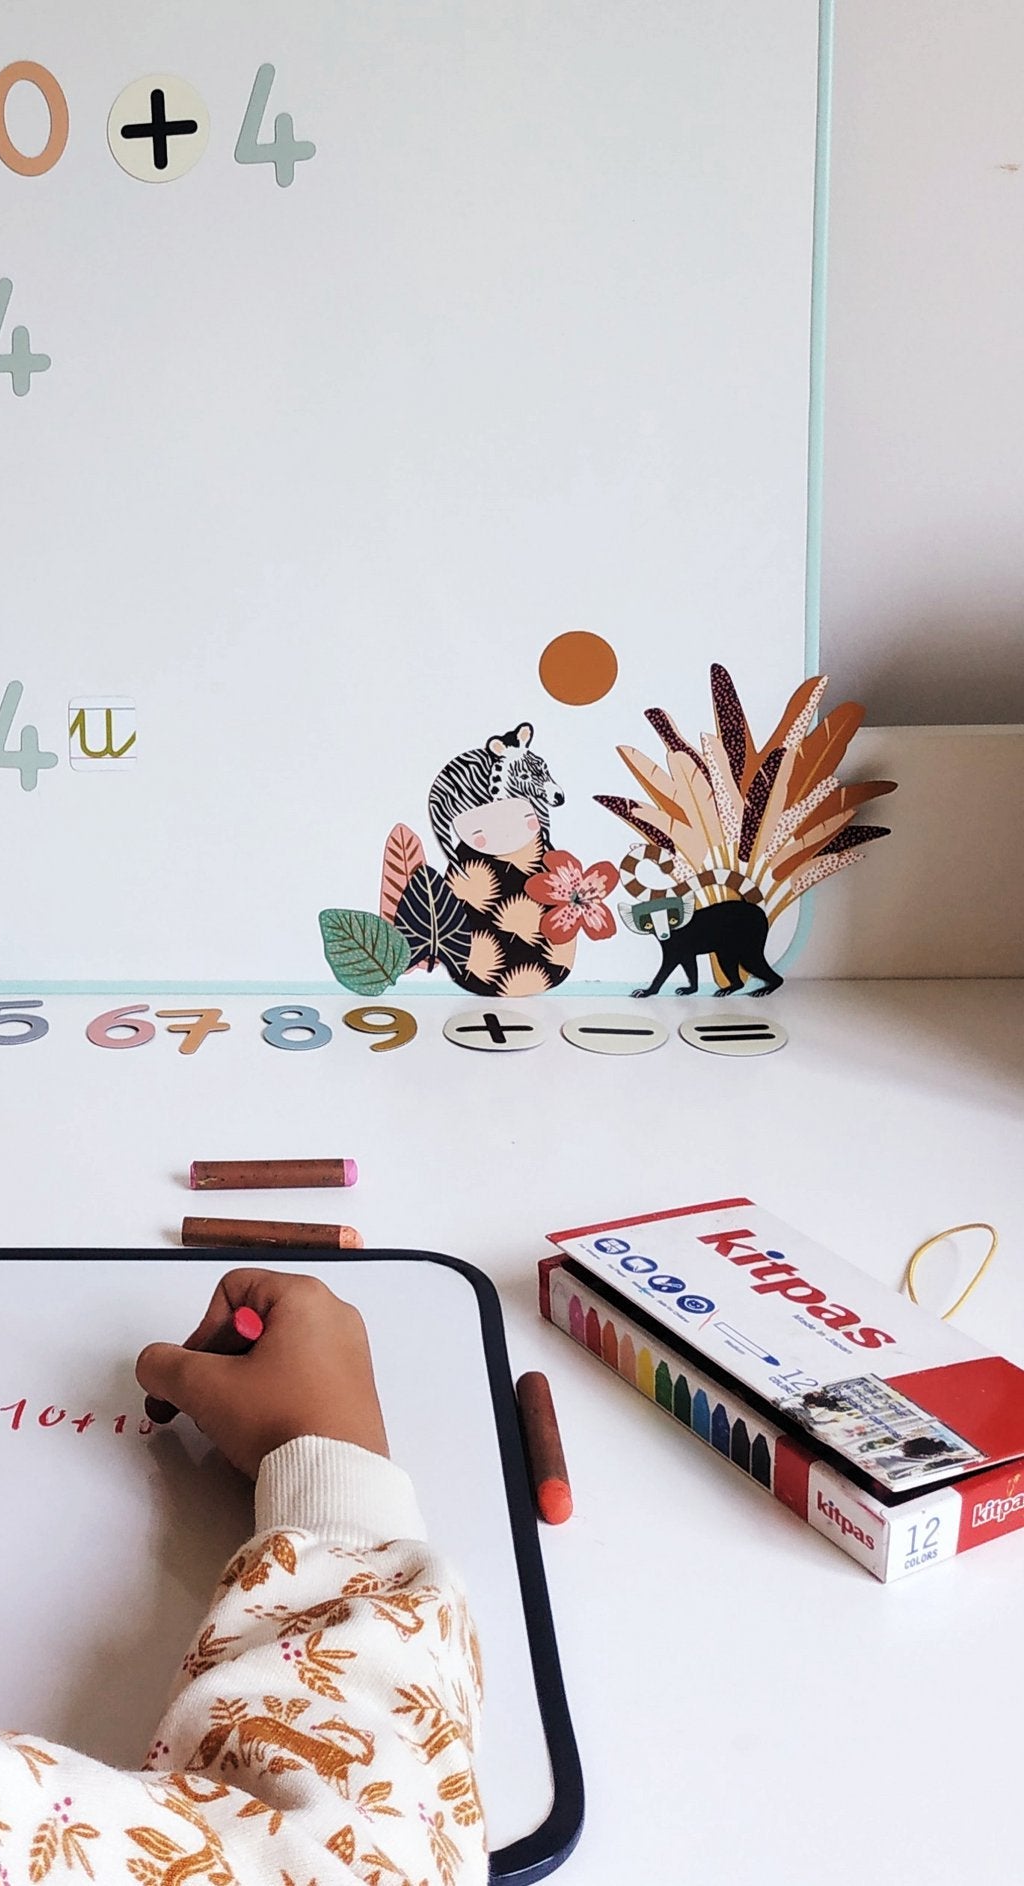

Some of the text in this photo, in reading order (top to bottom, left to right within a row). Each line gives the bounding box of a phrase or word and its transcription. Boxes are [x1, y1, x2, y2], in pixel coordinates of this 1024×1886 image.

[234, 62, 317, 188] 4
[85, 1003, 156, 1049] 6
[155, 1008, 231, 1055] 7
[262, 1004, 333, 1051] 8
[343, 1006, 417, 1053] 9
[696, 1228, 897, 1348] kitpas
[778, 1368, 819, 1391] 12
[816, 1490, 875, 1551] kitpas
[905, 1517, 941, 1556] 12
[904, 1549, 938, 1570] COLORS
